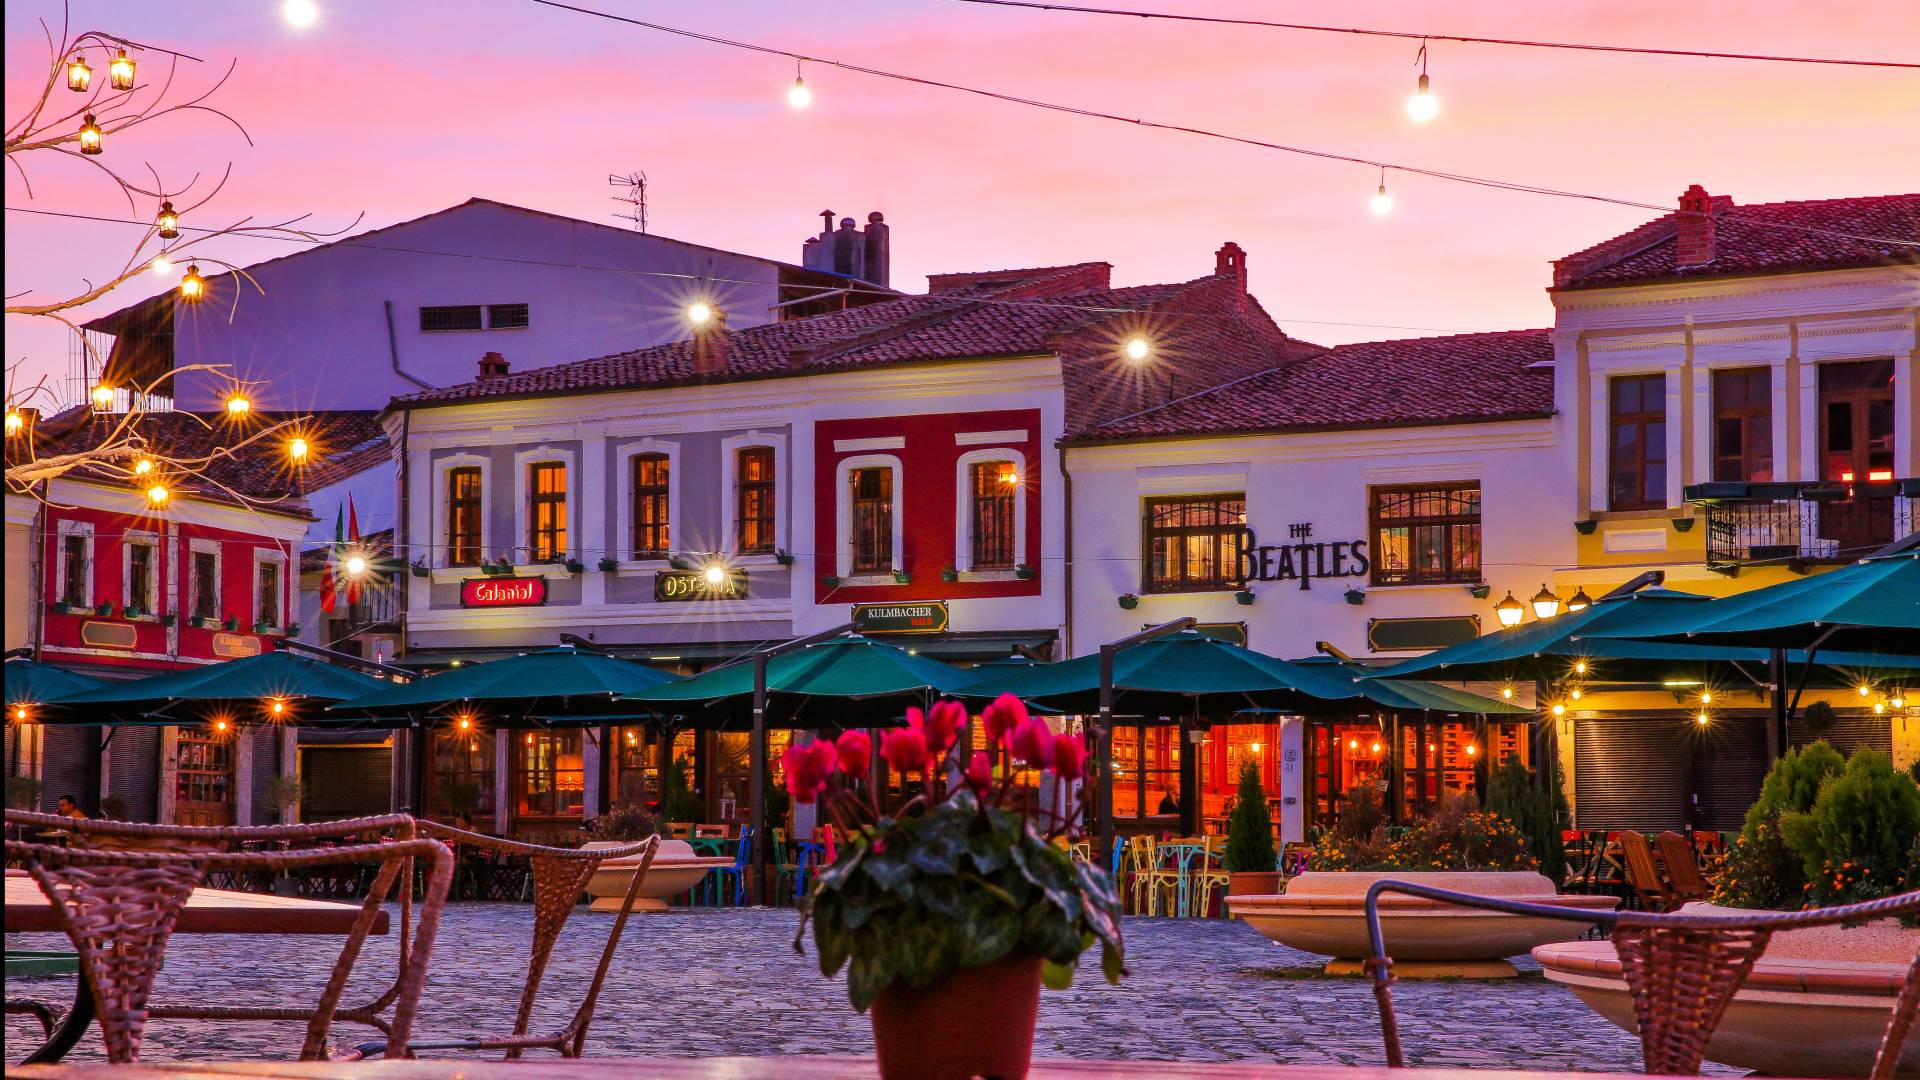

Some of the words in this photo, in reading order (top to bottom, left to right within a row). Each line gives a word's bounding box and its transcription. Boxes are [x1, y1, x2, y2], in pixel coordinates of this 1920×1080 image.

[1288, 522, 1313, 539] THE
[1236, 527, 1369, 590] BEATLES
[867, 607, 932, 618] KULMBACHER
